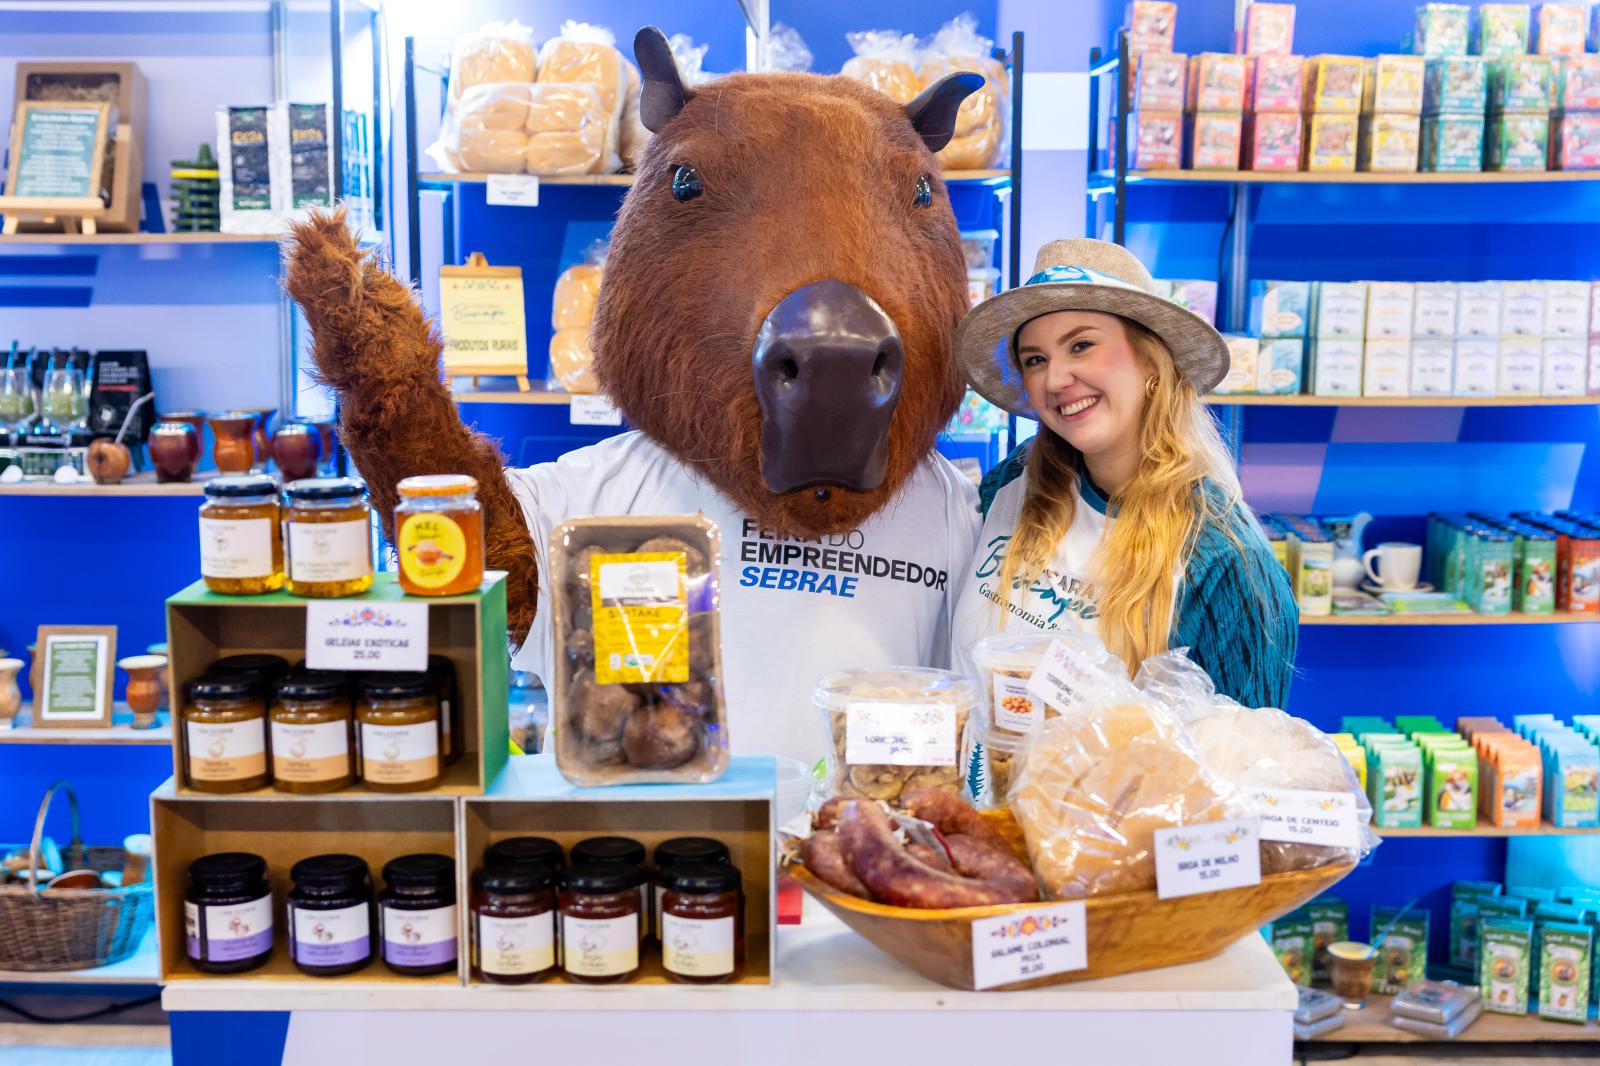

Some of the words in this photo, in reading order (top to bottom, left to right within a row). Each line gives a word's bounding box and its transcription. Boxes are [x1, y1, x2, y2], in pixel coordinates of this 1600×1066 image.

[448, 339, 489, 352] PRODUTOS
[492, 339, 518, 352] RURAIS
[741, 541, 948, 592] EMPREENDEDOR
[739, 566, 860, 599] SEBRAE
[1286, 816, 1297, 824] DE
[1301, 817, 1340, 827] CENTEIO
[1178, 861, 1199, 870] BROA
[1201, 858, 1211, 867] DE
[1214, 854, 1239, 865] MILHO
[991, 945, 1024, 958] SALAME
[1027, 936, 1070, 951] COLONIAL
